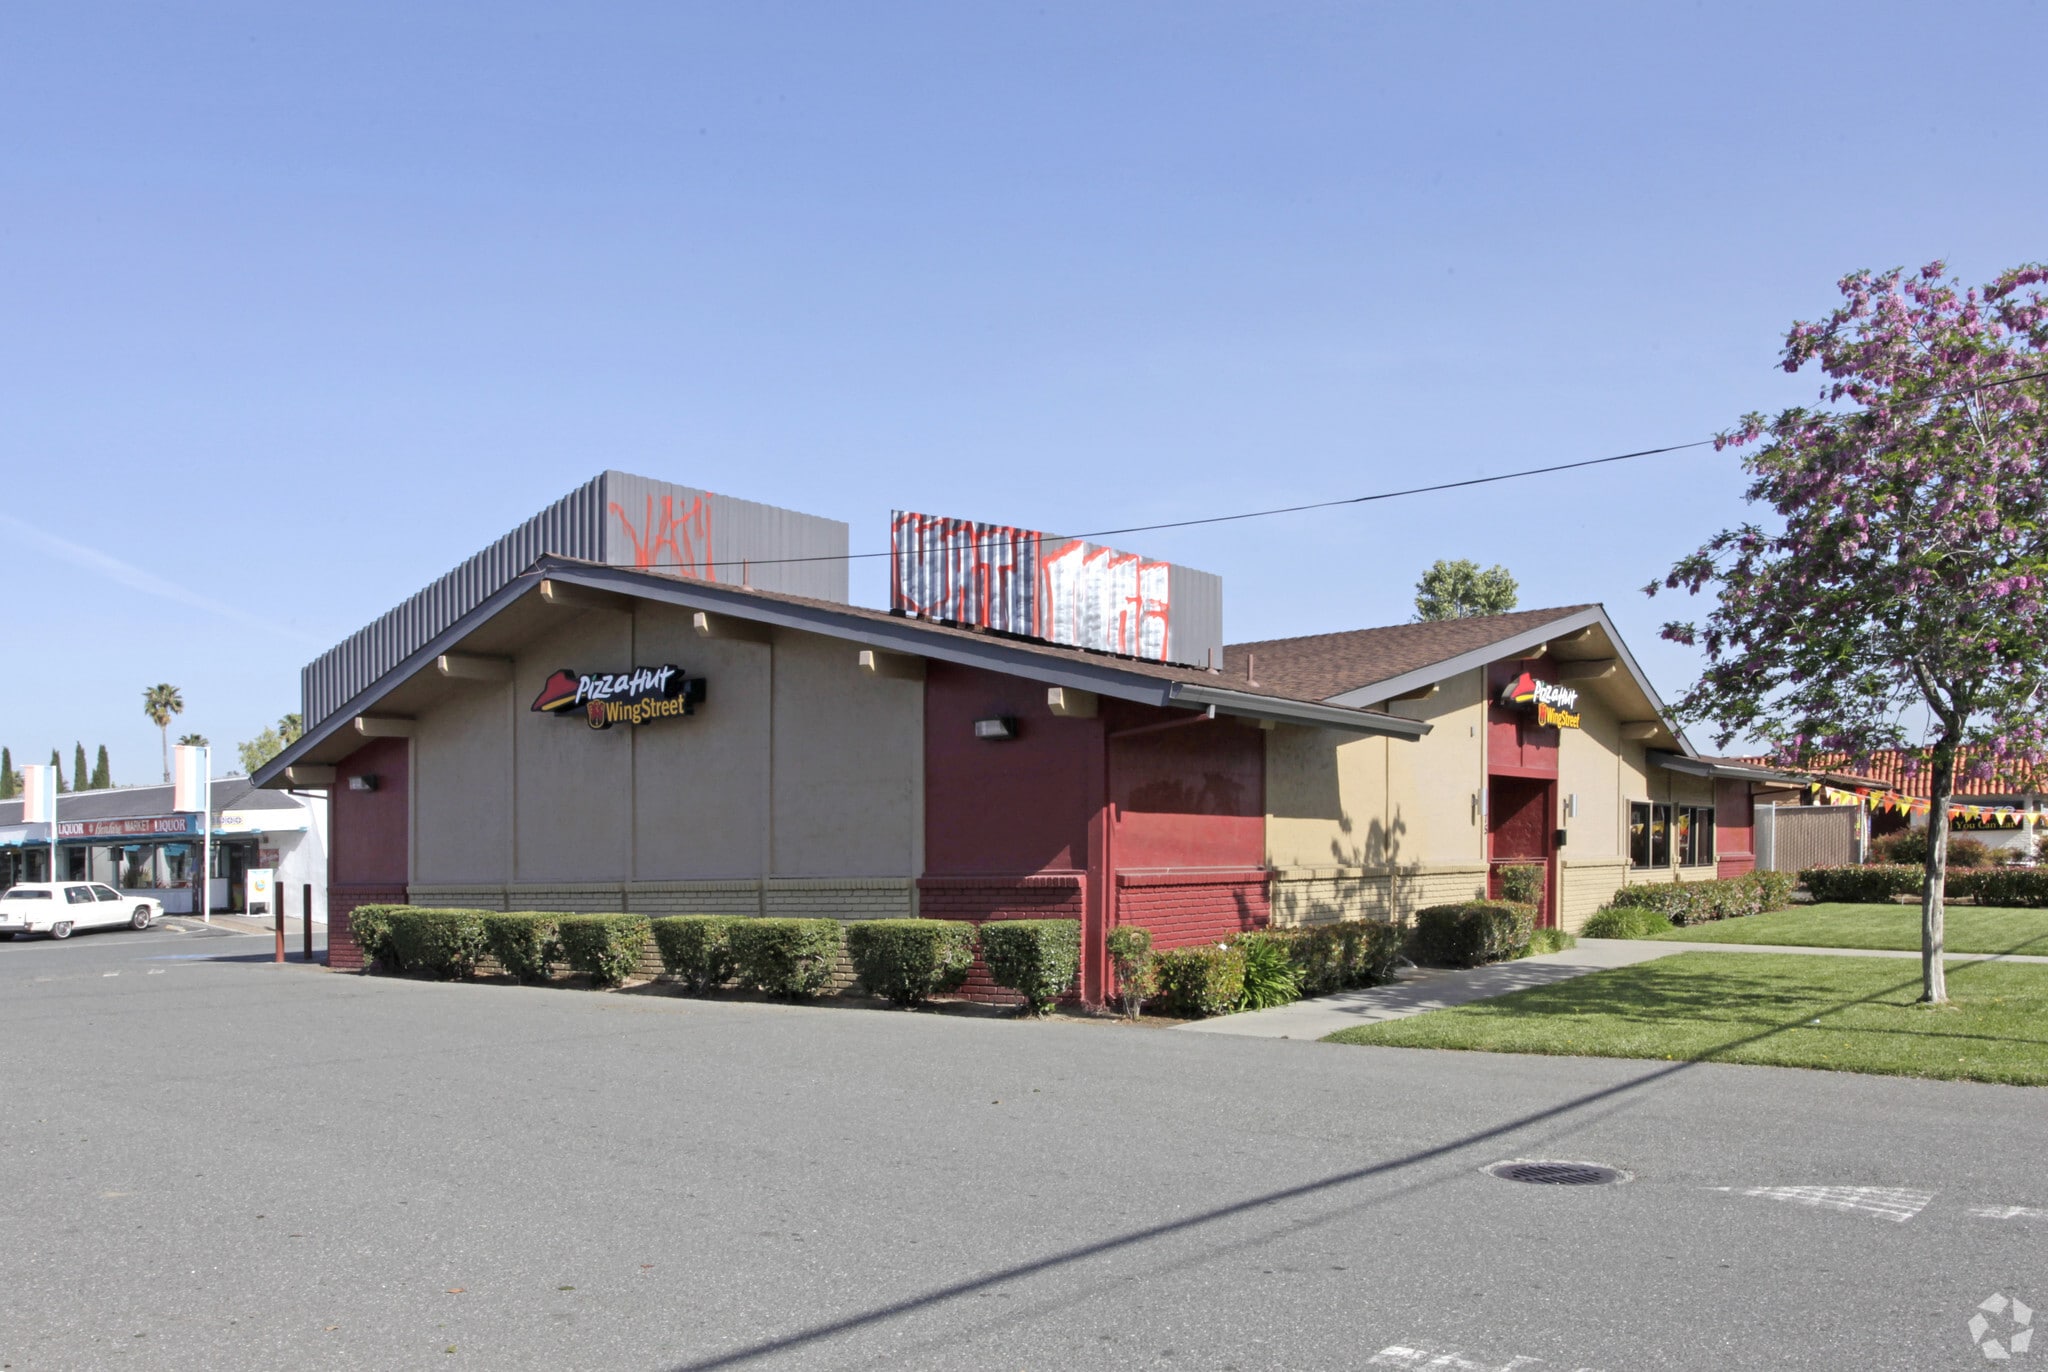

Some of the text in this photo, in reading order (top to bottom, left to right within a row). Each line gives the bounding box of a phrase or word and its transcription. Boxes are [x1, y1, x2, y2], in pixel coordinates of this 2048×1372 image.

[576, 666, 675, 704] Pizza Hut
[606, 694, 685, 724] WingStreet
[1547, 706, 1580, 729] WingStreet
[58, 822, 84, 836] LIQUOR
[124, 819, 150, 832] MARKET
[154, 818, 187, 832] LIQUOR
[1956, 820, 1976, 830] You
